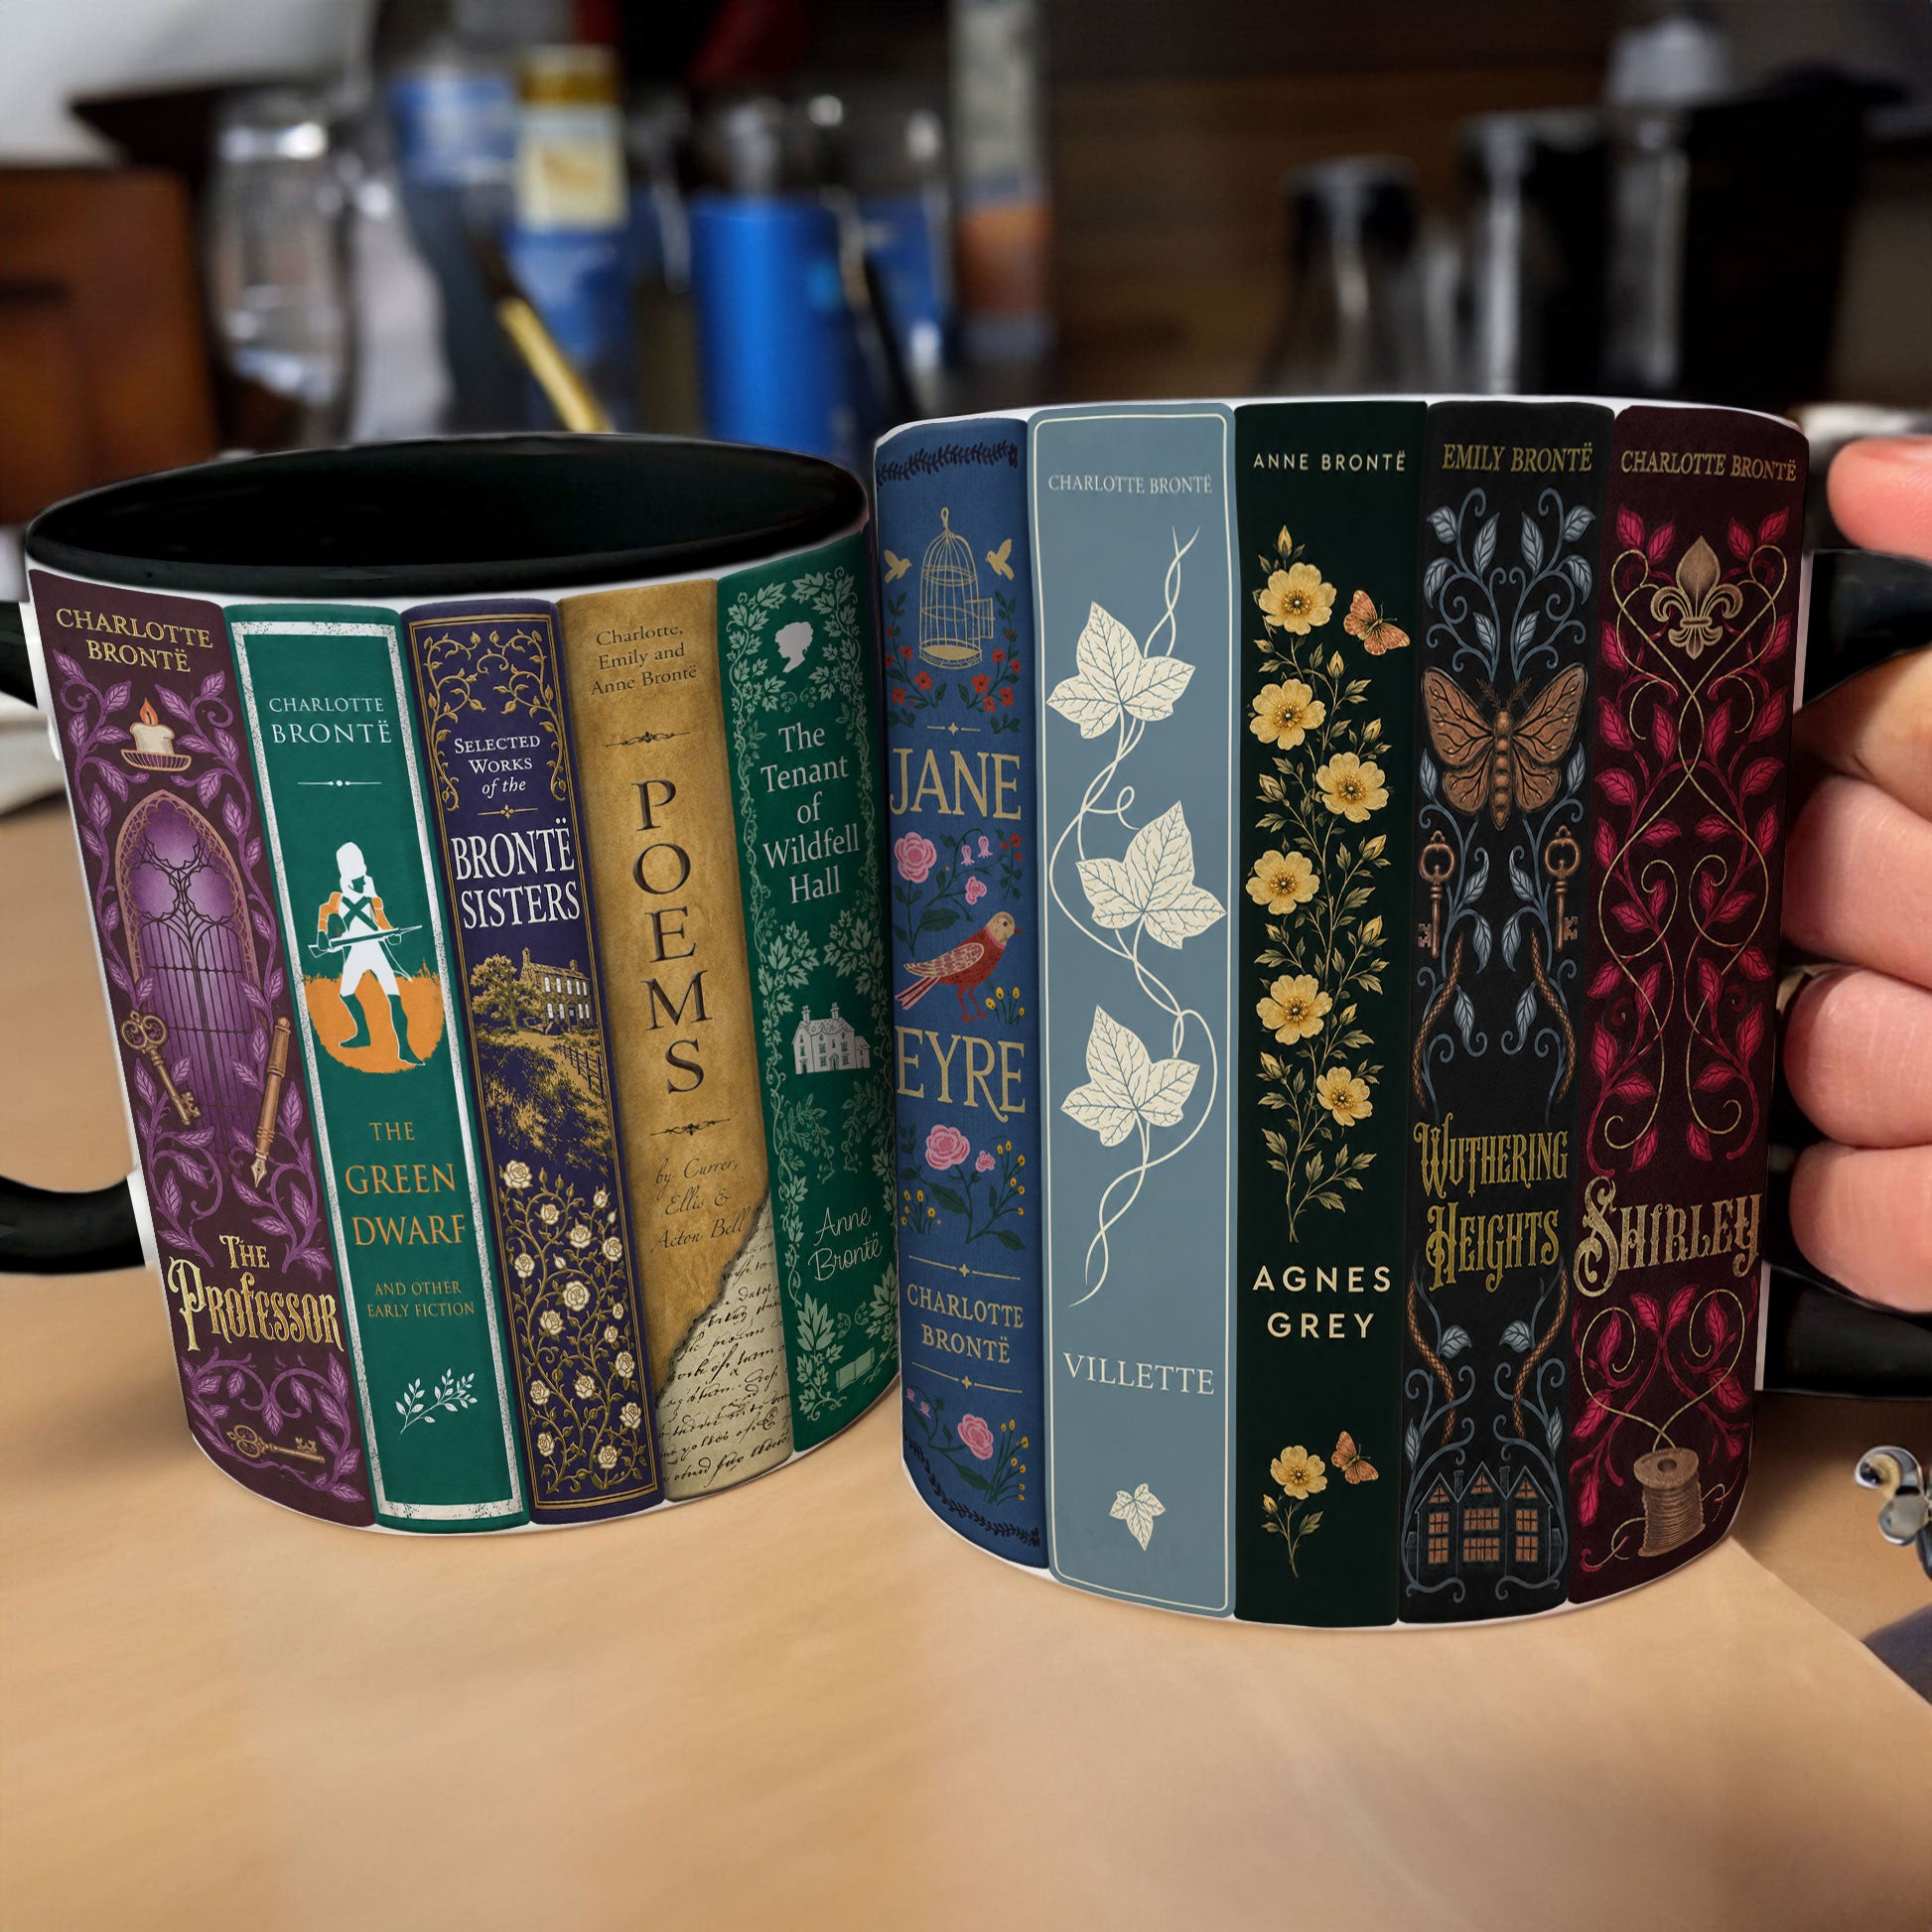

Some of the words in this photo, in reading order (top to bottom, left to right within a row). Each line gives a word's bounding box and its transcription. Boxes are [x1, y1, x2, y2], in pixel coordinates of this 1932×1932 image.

[1253, 452, 1309, 471] ANNE
[1320, 451, 1406, 472] BRONTË
[1442, 443, 1505, 472] EMILY
[1510, 442, 1593, 473] BRONTË
[1620, 450, 1726, 477] CHARLOTTE
[1730, 457, 1797, 483] BRONTË
[1048, 474, 1145, 493] CHARLOTTE
[1150, 474, 1212, 494] BRONTË
[56, 608, 213, 648] CHARLOTTE
[596, 624, 684, 645] Charlotte,
[85, 638, 192, 673] BRONTË
[598, 647, 647, 671] Emily
[654, 642, 685, 661] and
[591, 678, 635, 696] Anne
[641, 664, 698, 687] Brontë
[268, 697, 384, 713] CHARLOTTE
[271, 721, 392, 744] BRONTË
[454, 735, 540, 755] SELECTED
[778, 722, 826, 754] The
[469, 757, 533, 774] WORKS
[760, 756, 850, 793] Tenant
[482, 777, 500, 798] of
[502, 776, 526, 793] the
[889, 748, 1022, 821] JANE
[796, 791, 823, 824] of
[451, 817, 575, 881] BRONTË
[762, 822, 861, 870] Wildfell
[789, 865, 842, 904] Hall
[461, 881, 581, 930] SISTERS
[631, 778, 713, 1094] POEMS
[895, 1025, 1026, 1123] EYRE
[369, 1121, 415, 1142] THE
[345, 1163, 457, 1195] GREEN
[655, 1158, 673, 1200] by
[683, 1157, 739, 1179] Currer,
[664, 1186, 704, 1216] Ellis
[714, 1188, 732, 1206] &
[351, 1214, 466, 1246] DWARF
[650, 1228, 702, 1254] Acton
[710, 1205, 752, 1239] Bell
[812, 1206, 872, 1247] Anne
[807, 1231, 884, 1282] Brontë
[374, 1282, 406, 1297] AND
[411, 1280, 462, 1296] OTHER
[1252, 1265, 1391, 1293] AGNES
[367, 1303, 410, 1318] EARLY
[415, 1302, 475, 1317] FICTION
[906, 1283, 1024, 1328] CHARLOTTE
[1267, 1311, 1374, 1339] GREY
[921, 1322, 1011, 1365] BRONTË
[1062, 1351, 1215, 1395] VILLETTE
